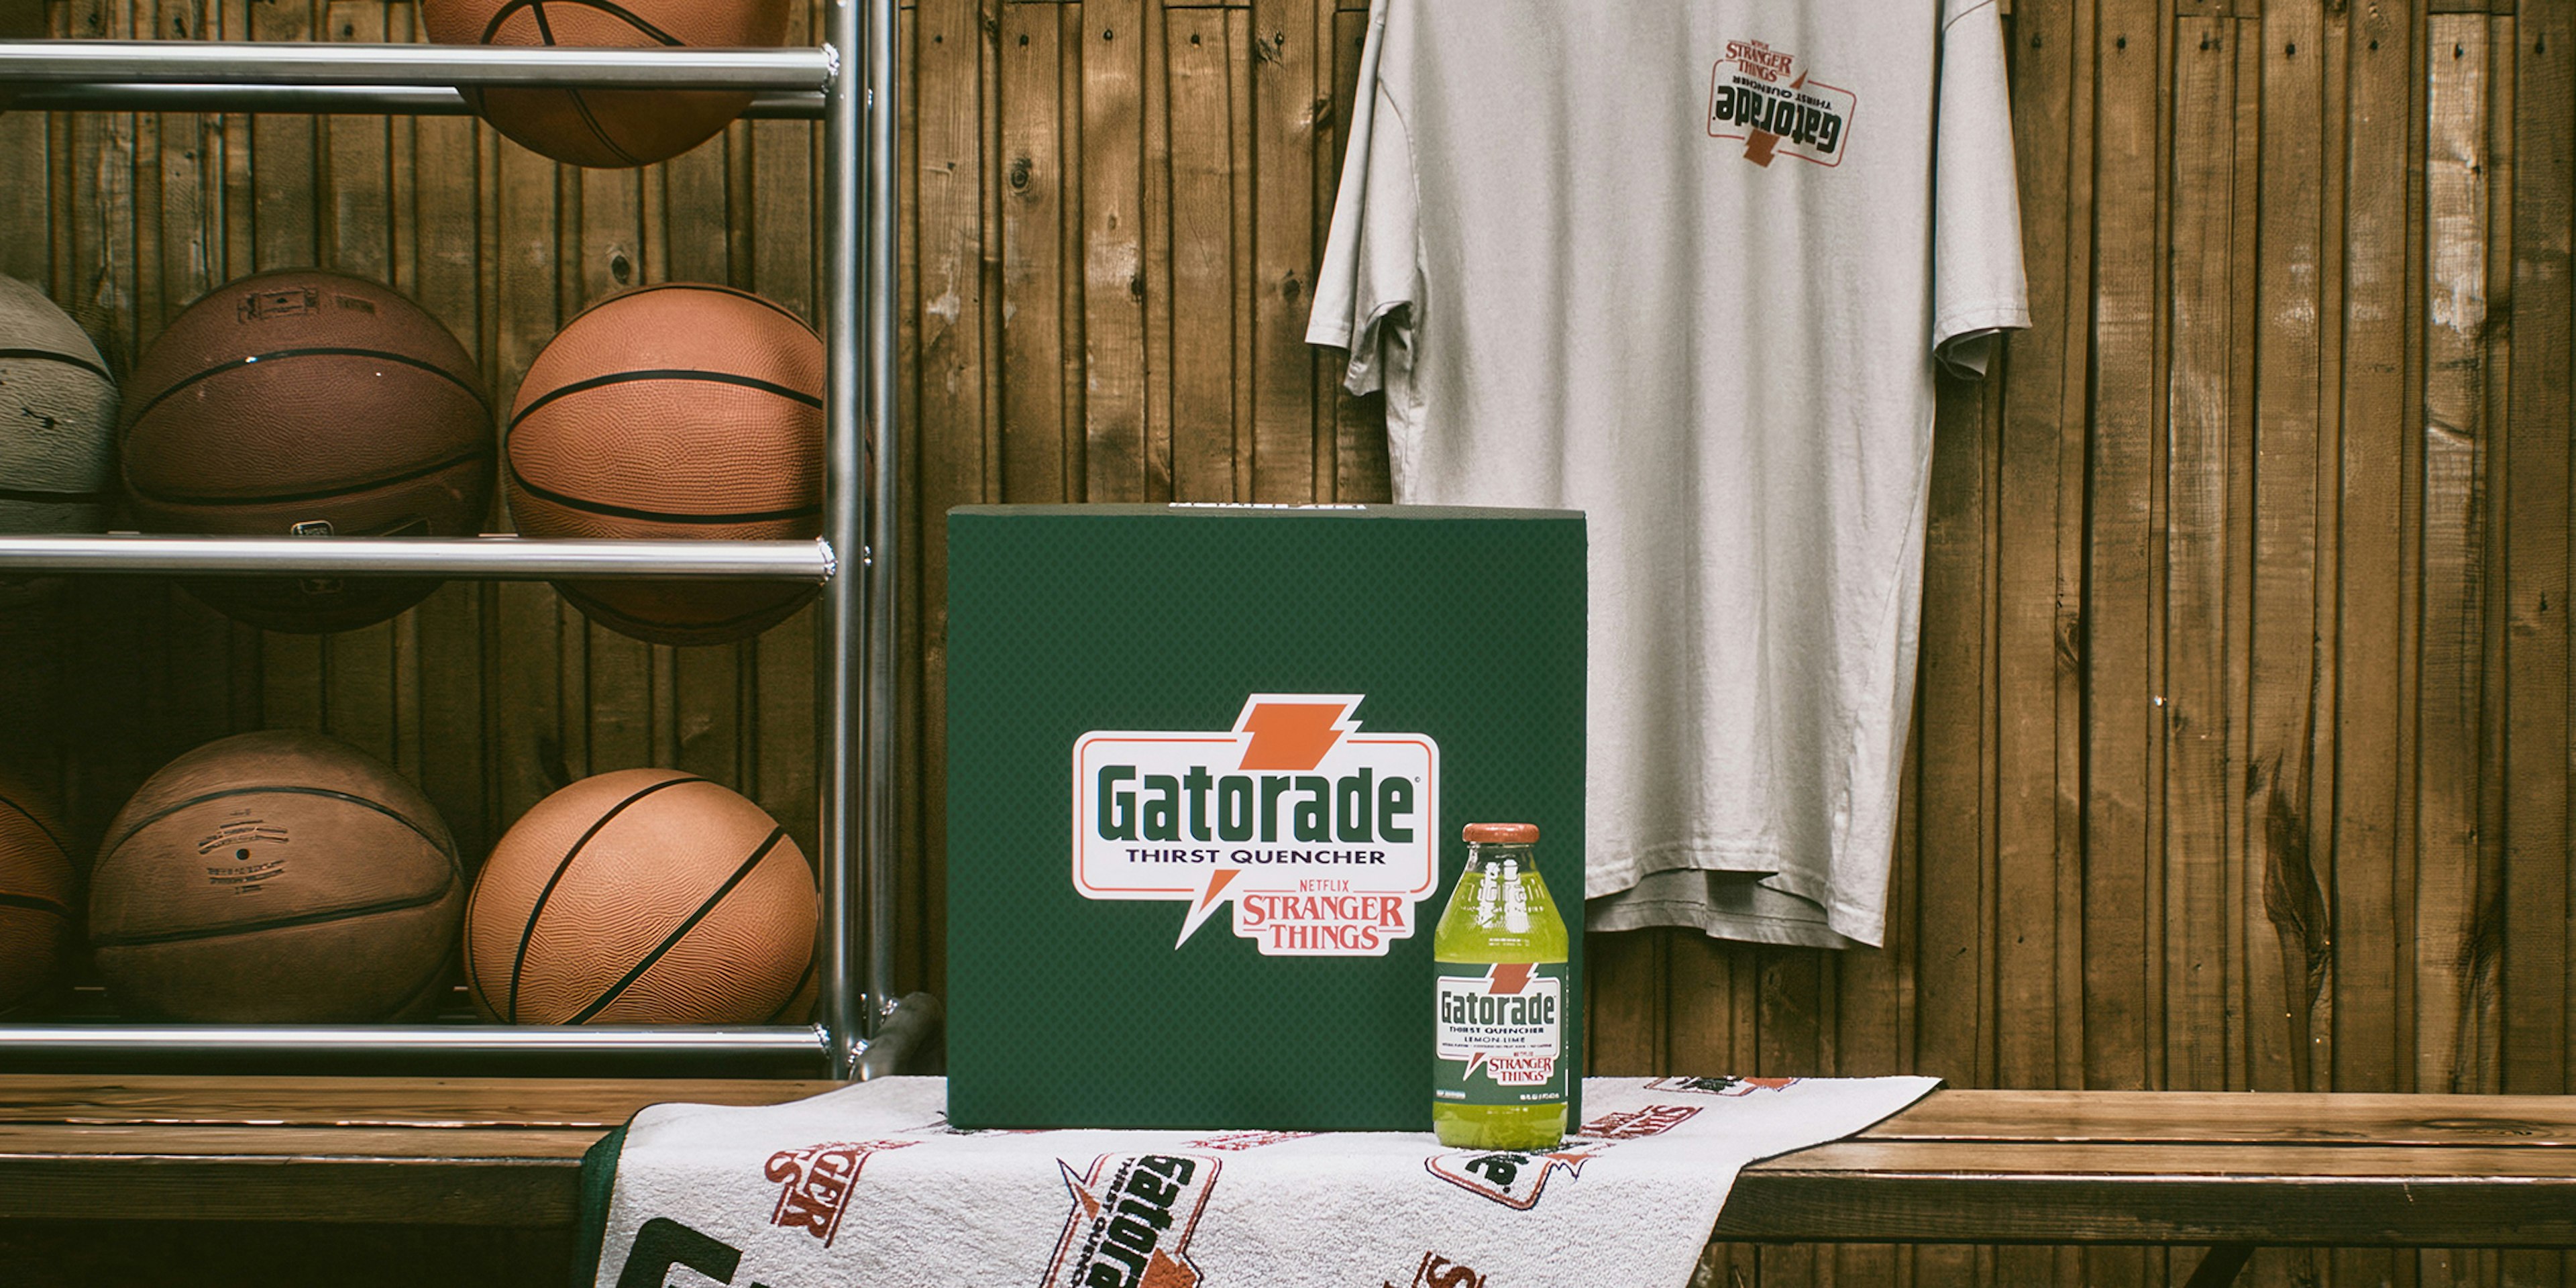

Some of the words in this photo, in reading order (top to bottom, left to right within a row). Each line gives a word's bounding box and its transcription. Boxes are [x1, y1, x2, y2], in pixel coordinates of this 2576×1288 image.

[1725, 42, 1792, 74] STRANGER
[1738, 59, 1778, 83] THINGS
[1733, 75, 1792, 99] QUENCHER
[1795, 93, 1832, 110] THIRST
[1716, 85, 1842, 154] Gatorade
[1098, 765, 1413, 843] Gatorade
[1126, 849, 1220, 863] THIRST
[1230, 850, 1387, 865] QUENCHER
[1299, 880, 1349, 893] NETFLIX
[1243, 894, 1405, 927] STRANGER
[1275, 925, 1379, 950] THINGS
[1442, 991, 1554, 1025] Gatorade
[1489, 1058, 1552, 1071] STRANGER
[1501, 1071, 1544, 1081] THINGS
[1102, 1157, 1136, 1213] THIRST
[1085, 1155, 1196, 1288] Gatora
[1070, 1217, 1107, 1288] QUENC
